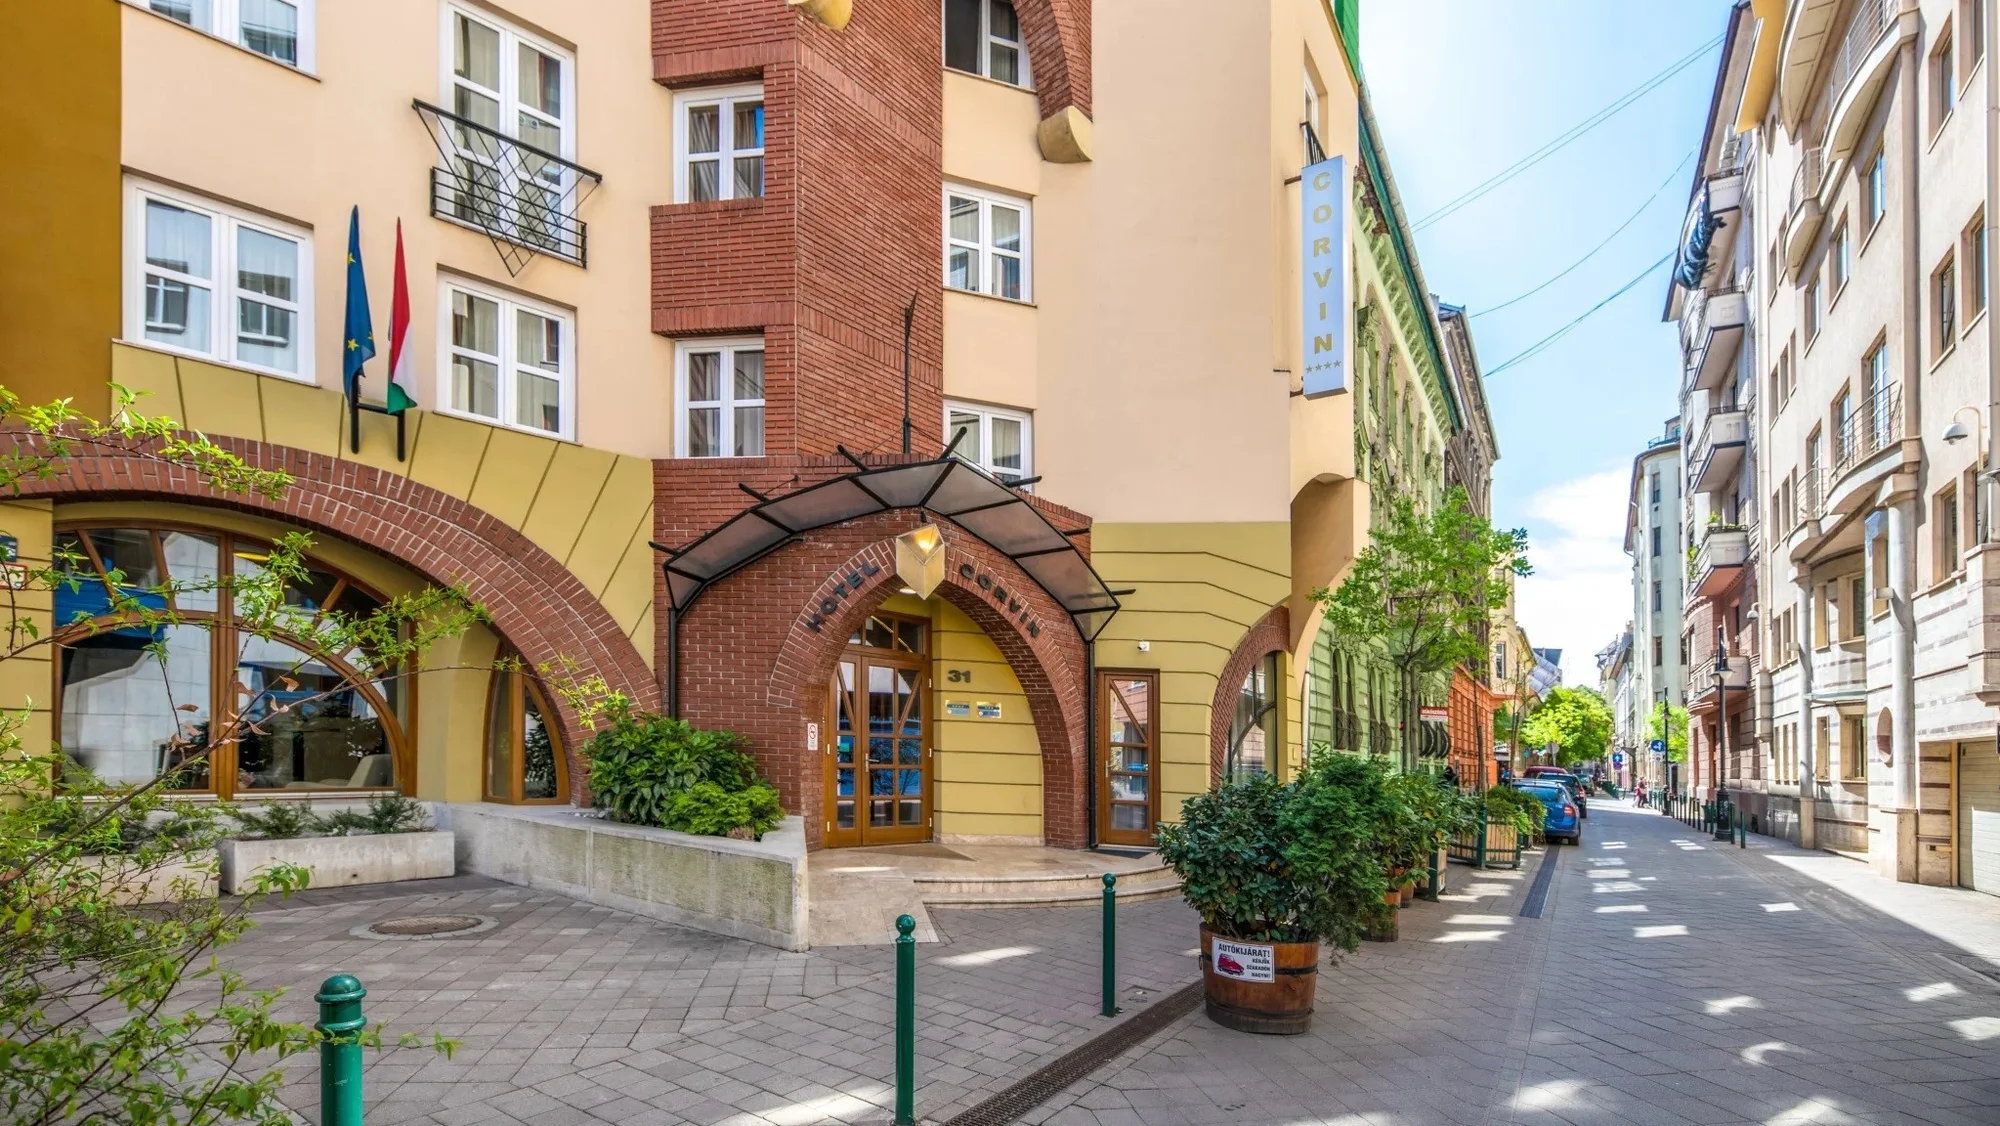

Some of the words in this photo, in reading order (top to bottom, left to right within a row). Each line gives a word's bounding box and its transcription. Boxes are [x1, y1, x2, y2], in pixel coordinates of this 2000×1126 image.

[1313, 172, 1333, 355] CORVIN
[806, 563, 878, 632] HOTEL
[960, 563, 1039, 638] CORVIN
[947, 669, 971, 683] 31
[1218, 943, 1270, 958] AUTÓKIJÁRAT!
